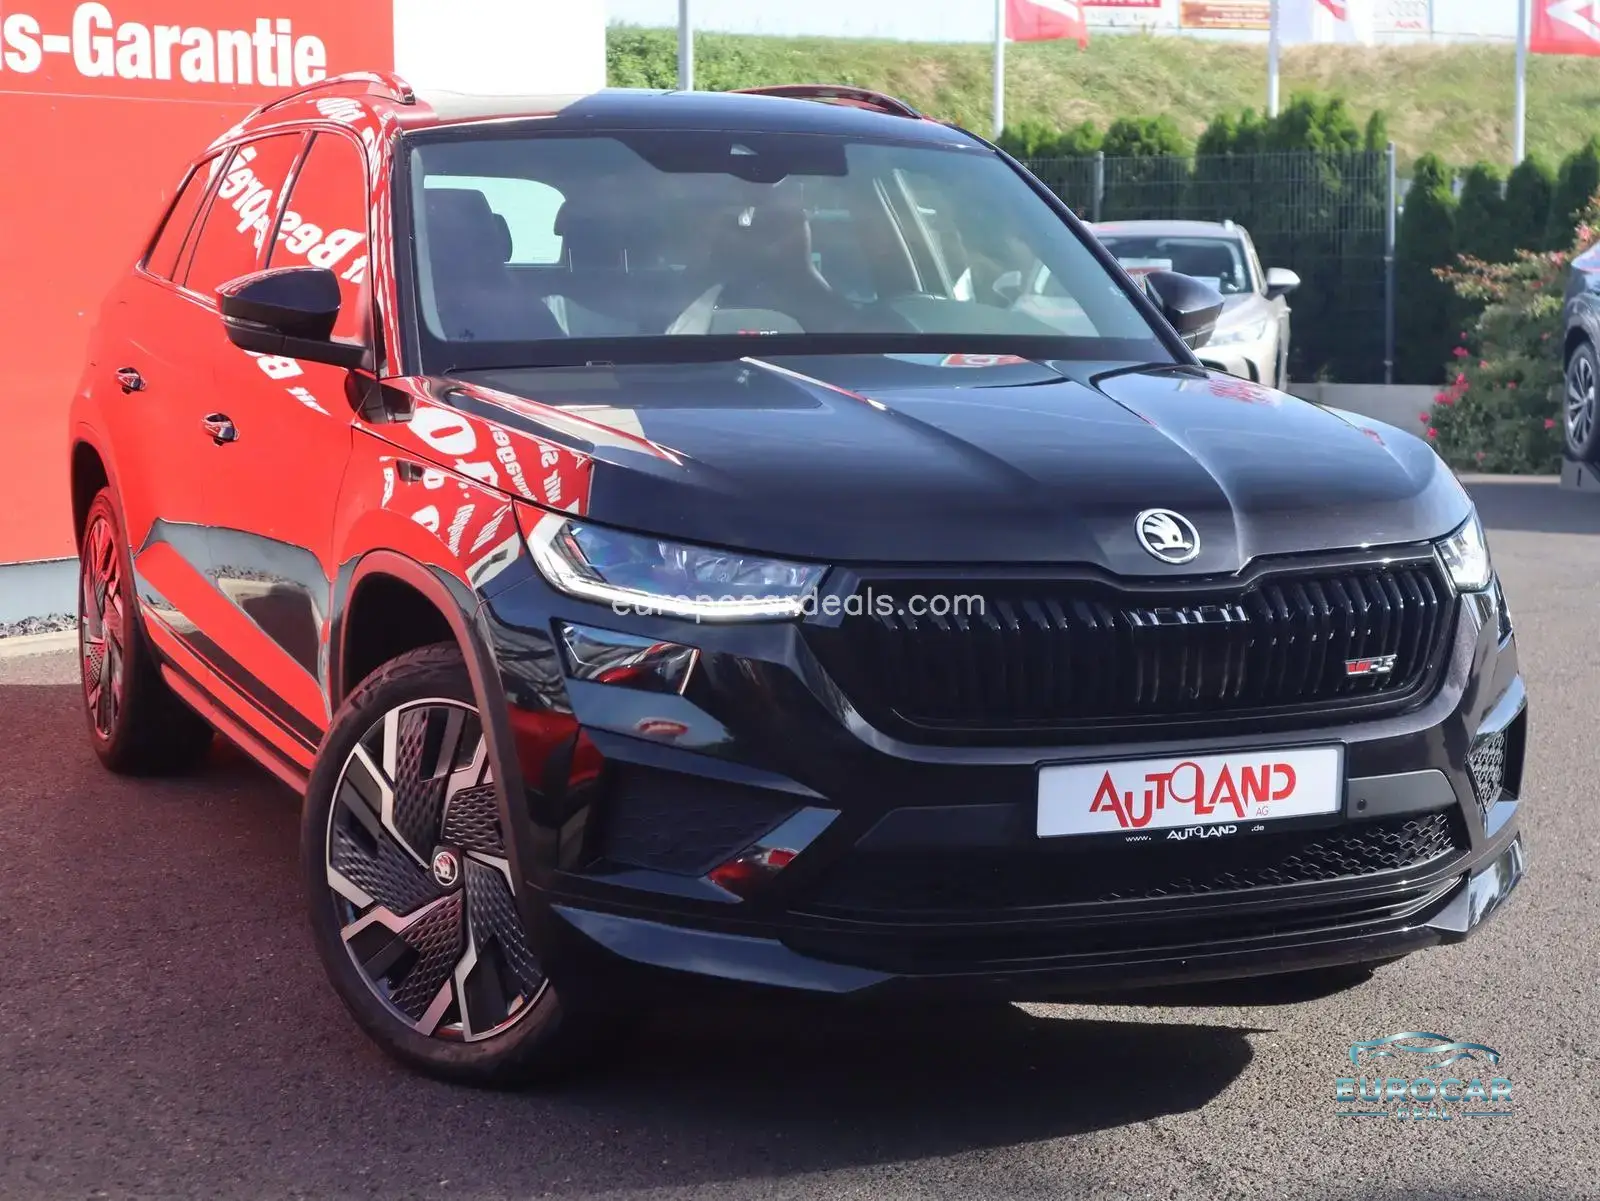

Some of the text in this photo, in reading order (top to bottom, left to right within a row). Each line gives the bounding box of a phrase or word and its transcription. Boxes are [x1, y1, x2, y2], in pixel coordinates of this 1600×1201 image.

[0, 1, 327, 87] s-Garantie
[1089, 761, 1297, 829] AUTOLAND
[1255, 806, 1270, 817] AG
[1166, 825, 1238, 840] AUTOLAND
